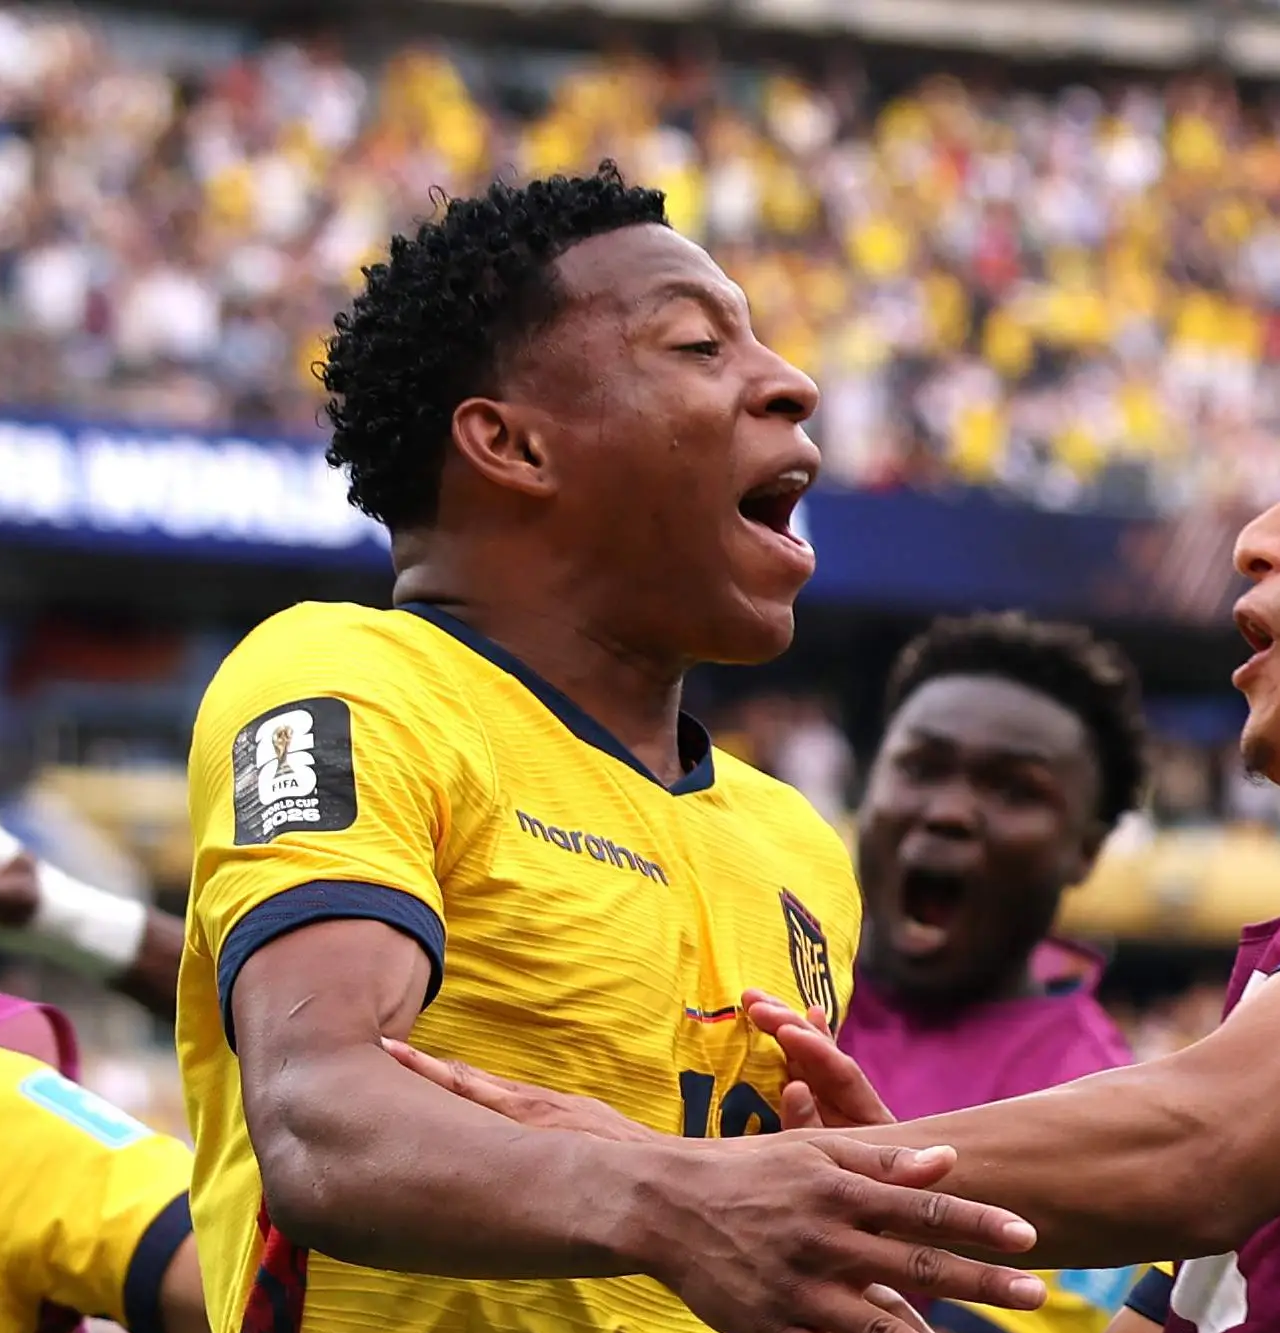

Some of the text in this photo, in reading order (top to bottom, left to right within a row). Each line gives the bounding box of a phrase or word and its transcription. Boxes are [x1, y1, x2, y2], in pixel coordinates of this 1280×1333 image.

[272, 779, 299, 792] FIFA
[261, 798, 319, 820] WORLD CUP
[262, 807, 321, 835] 2026
[515, 808, 669, 887] marathon
